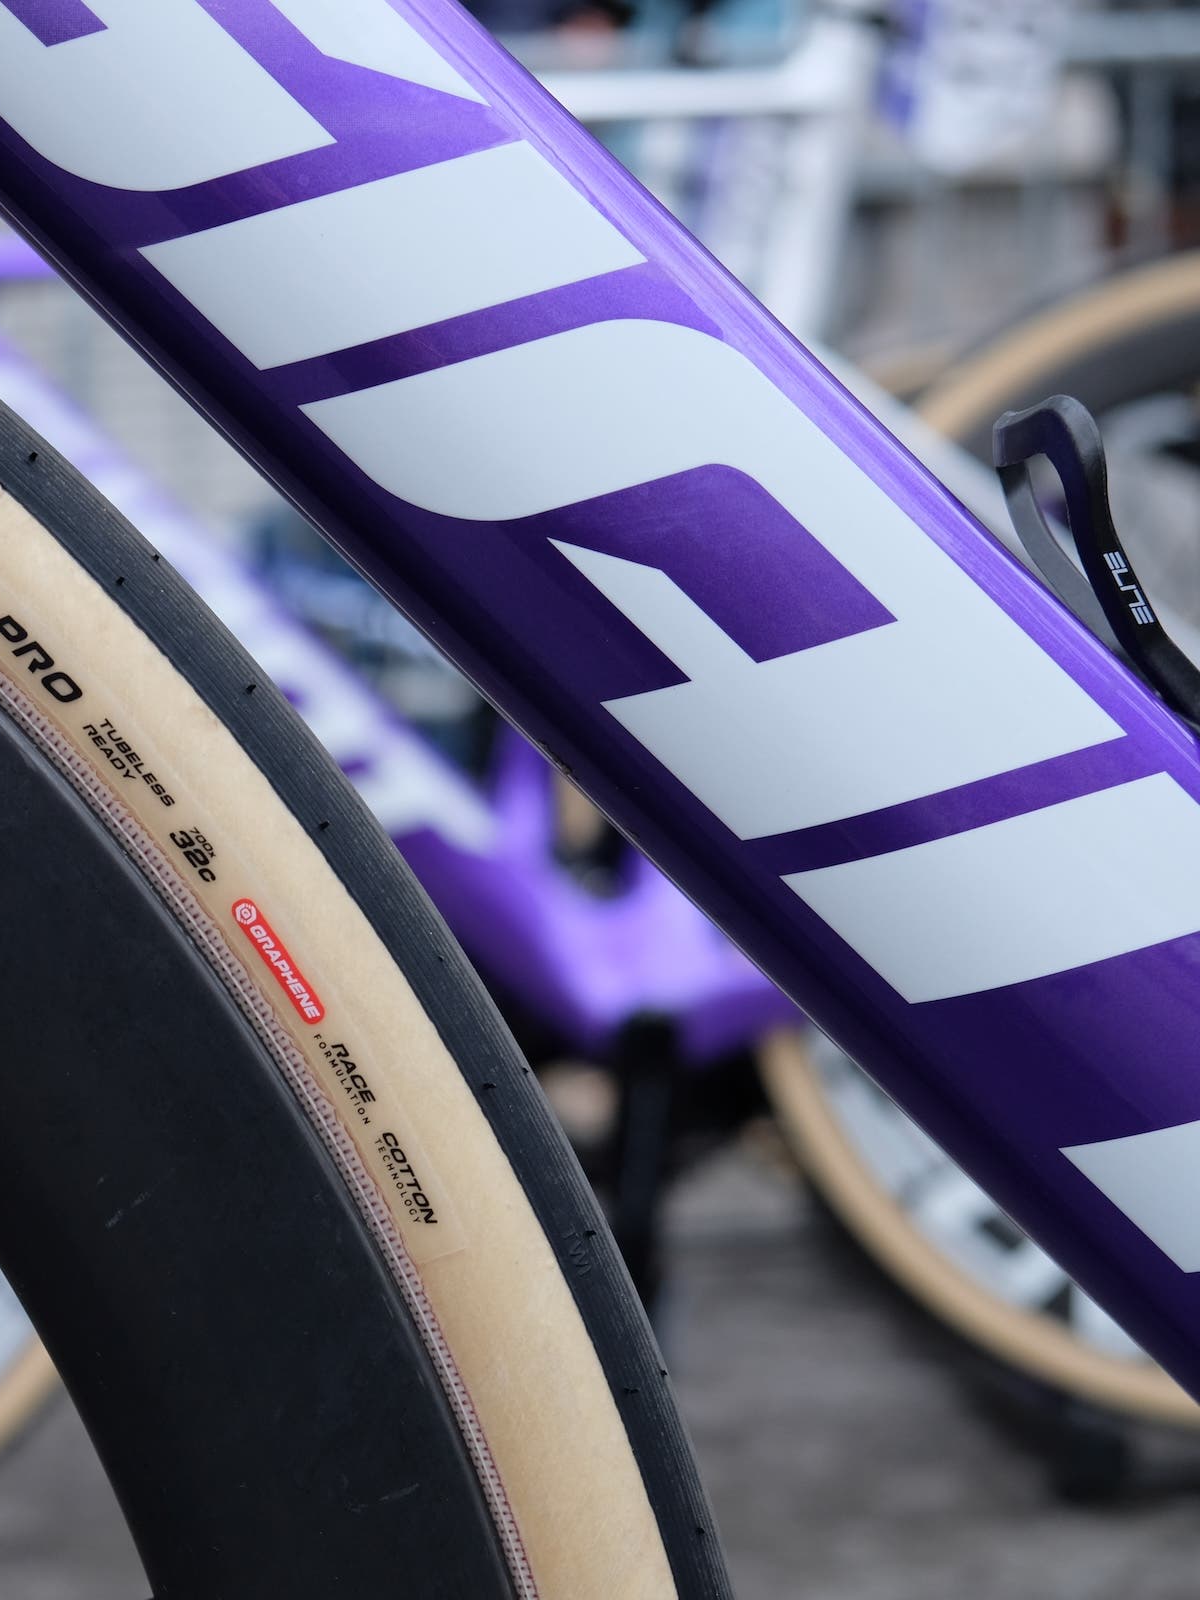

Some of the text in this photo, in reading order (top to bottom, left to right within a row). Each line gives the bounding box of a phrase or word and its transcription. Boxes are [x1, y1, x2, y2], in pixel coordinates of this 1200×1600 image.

[1103, 551, 1154, 625] ELITE
[83, 724, 136, 780] READY
[100, 718, 175, 807] TUBELESS
[249, 924, 321, 1019] GRAPHENE
[313, 1034, 371, 1125] FORMULATION
[331, 1043, 376, 1104] RACE
[375, 1138, 422, 1223] TECHNOLOGY
[382, 1132, 438, 1225] COTTON
